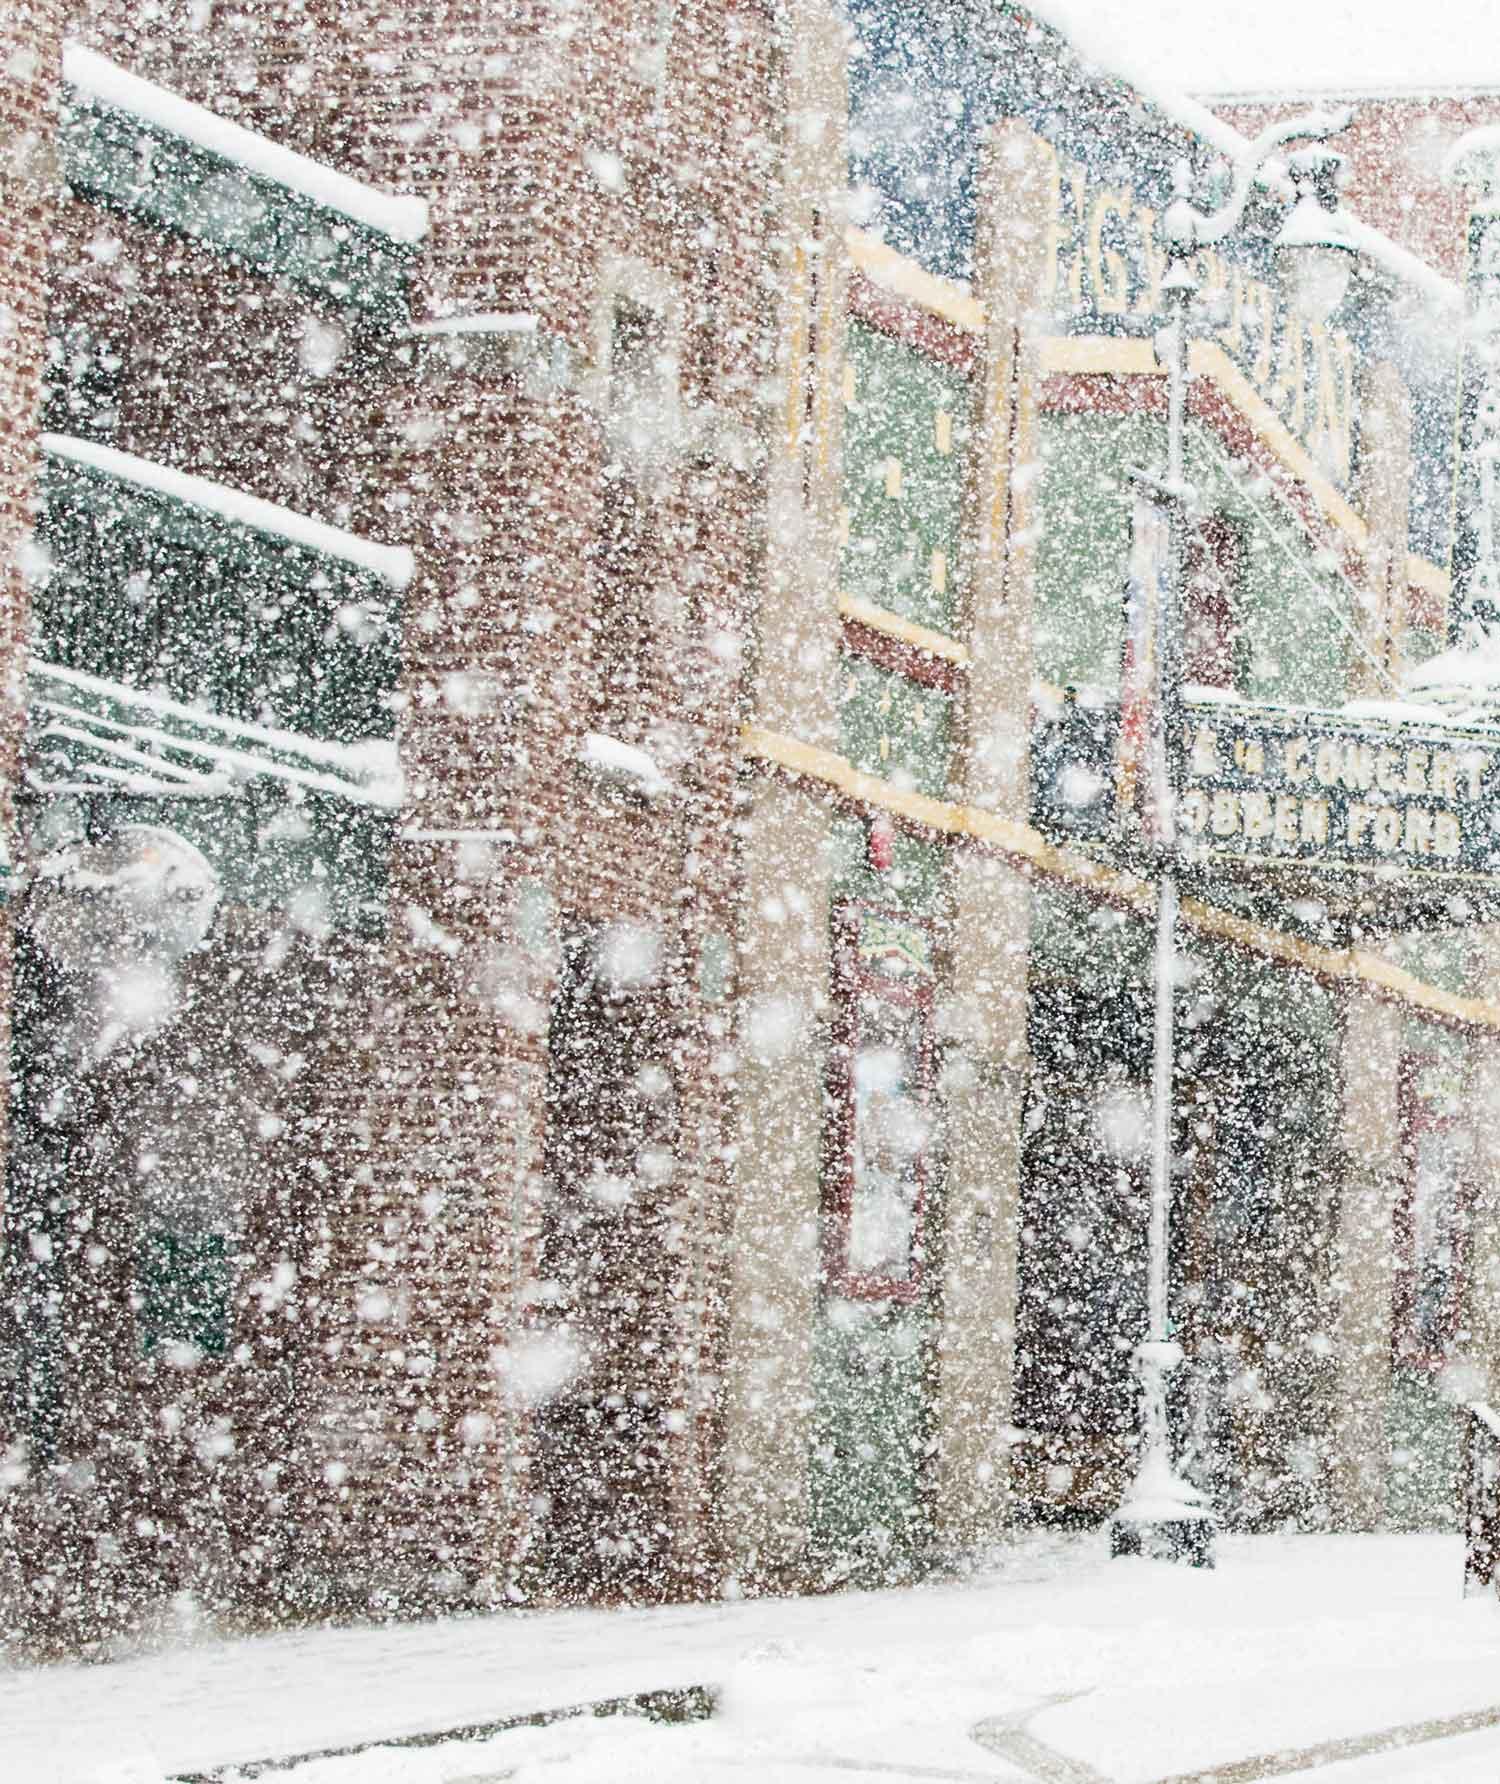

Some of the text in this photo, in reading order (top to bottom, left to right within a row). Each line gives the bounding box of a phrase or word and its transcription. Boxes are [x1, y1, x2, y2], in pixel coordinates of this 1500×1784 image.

[1283, 737, 1489, 800] CONCERT
[1178, 787, 1462, 857] OBBEN FORD
